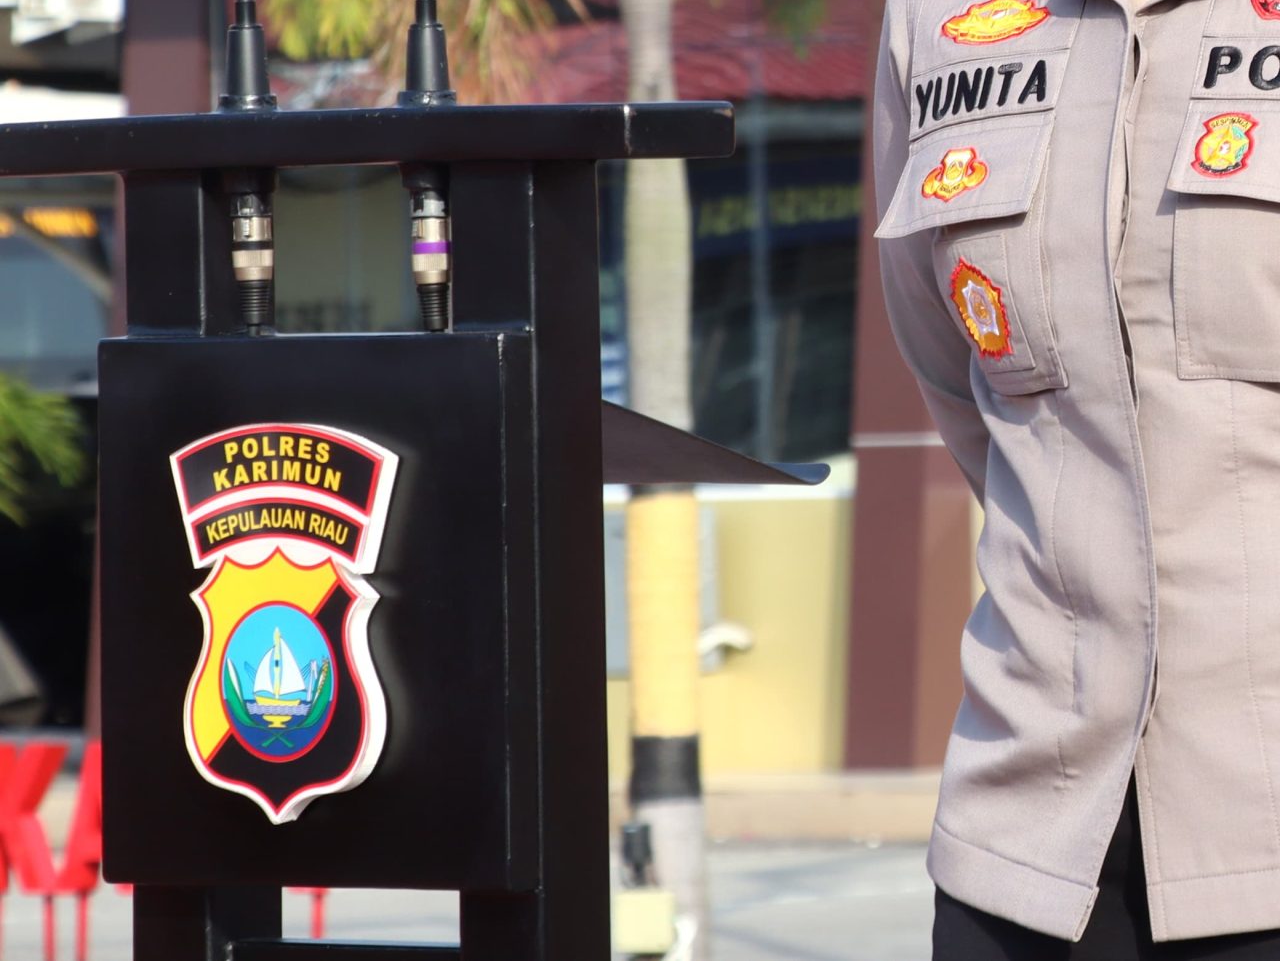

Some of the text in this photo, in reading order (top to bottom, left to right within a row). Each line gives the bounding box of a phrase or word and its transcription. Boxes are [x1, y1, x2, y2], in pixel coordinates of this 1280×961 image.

[914, 59, 1048, 129] YUNITA
[224, 435, 331, 464] POLRES
[212, 460, 342, 493] KARIMUN
[205, 507, 348, 545] KEPULAUAN RIAU
